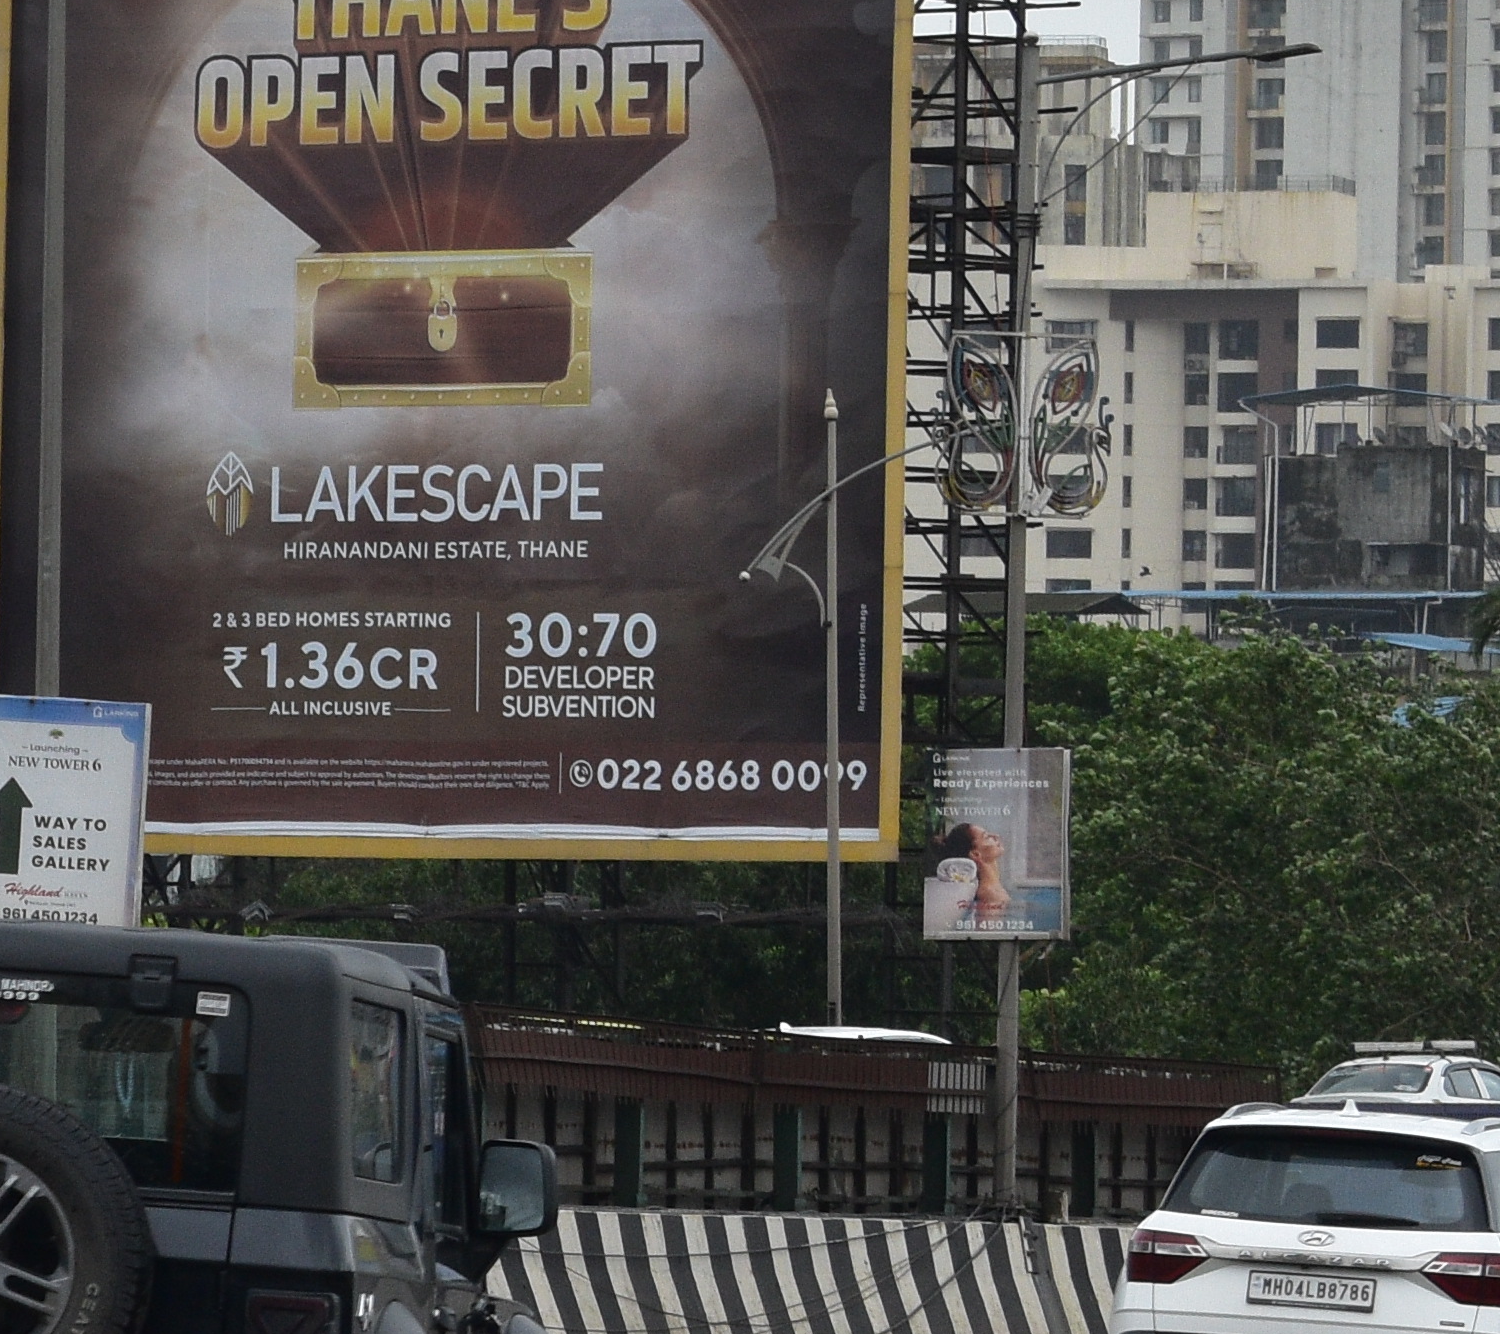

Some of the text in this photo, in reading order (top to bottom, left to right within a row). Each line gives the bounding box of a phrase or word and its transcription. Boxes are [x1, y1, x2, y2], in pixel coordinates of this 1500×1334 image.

[196, 40, 703, 149] OPEN SECRET
[270, 462, 604, 523] LAKESCAPE
[283, 539, 589, 562] HIRANANDANI ESTATE, THANE
[212, 612, 452, 629] 2 & 3 BED HOMES STARTING
[504, 611, 658, 660] 30:70
[260, 641, 439, 691] 1.36CR
[857, 603, 869, 713] Representative Image
[504, 665, 656, 691] DEVELOPER
[268, 701, 392, 716] ALL INCLUSIVE
[501, 694, 656, 719] SUBVENTION
[8, 755, 102, 772] NEW TOWER 6
[597, 758, 662, 792] 022
[671, 759, 760, 793] 6868
[933, 778, 1049, 791] Ready Experiences
[34, 814, 107, 832] WAY TO
[32, 834, 87, 851] SALES
[31, 854, 111, 873] GALLERY
[4, 881, 64, 901] Highland
[1261, 1276, 1371, 1303] MH04LB8786
